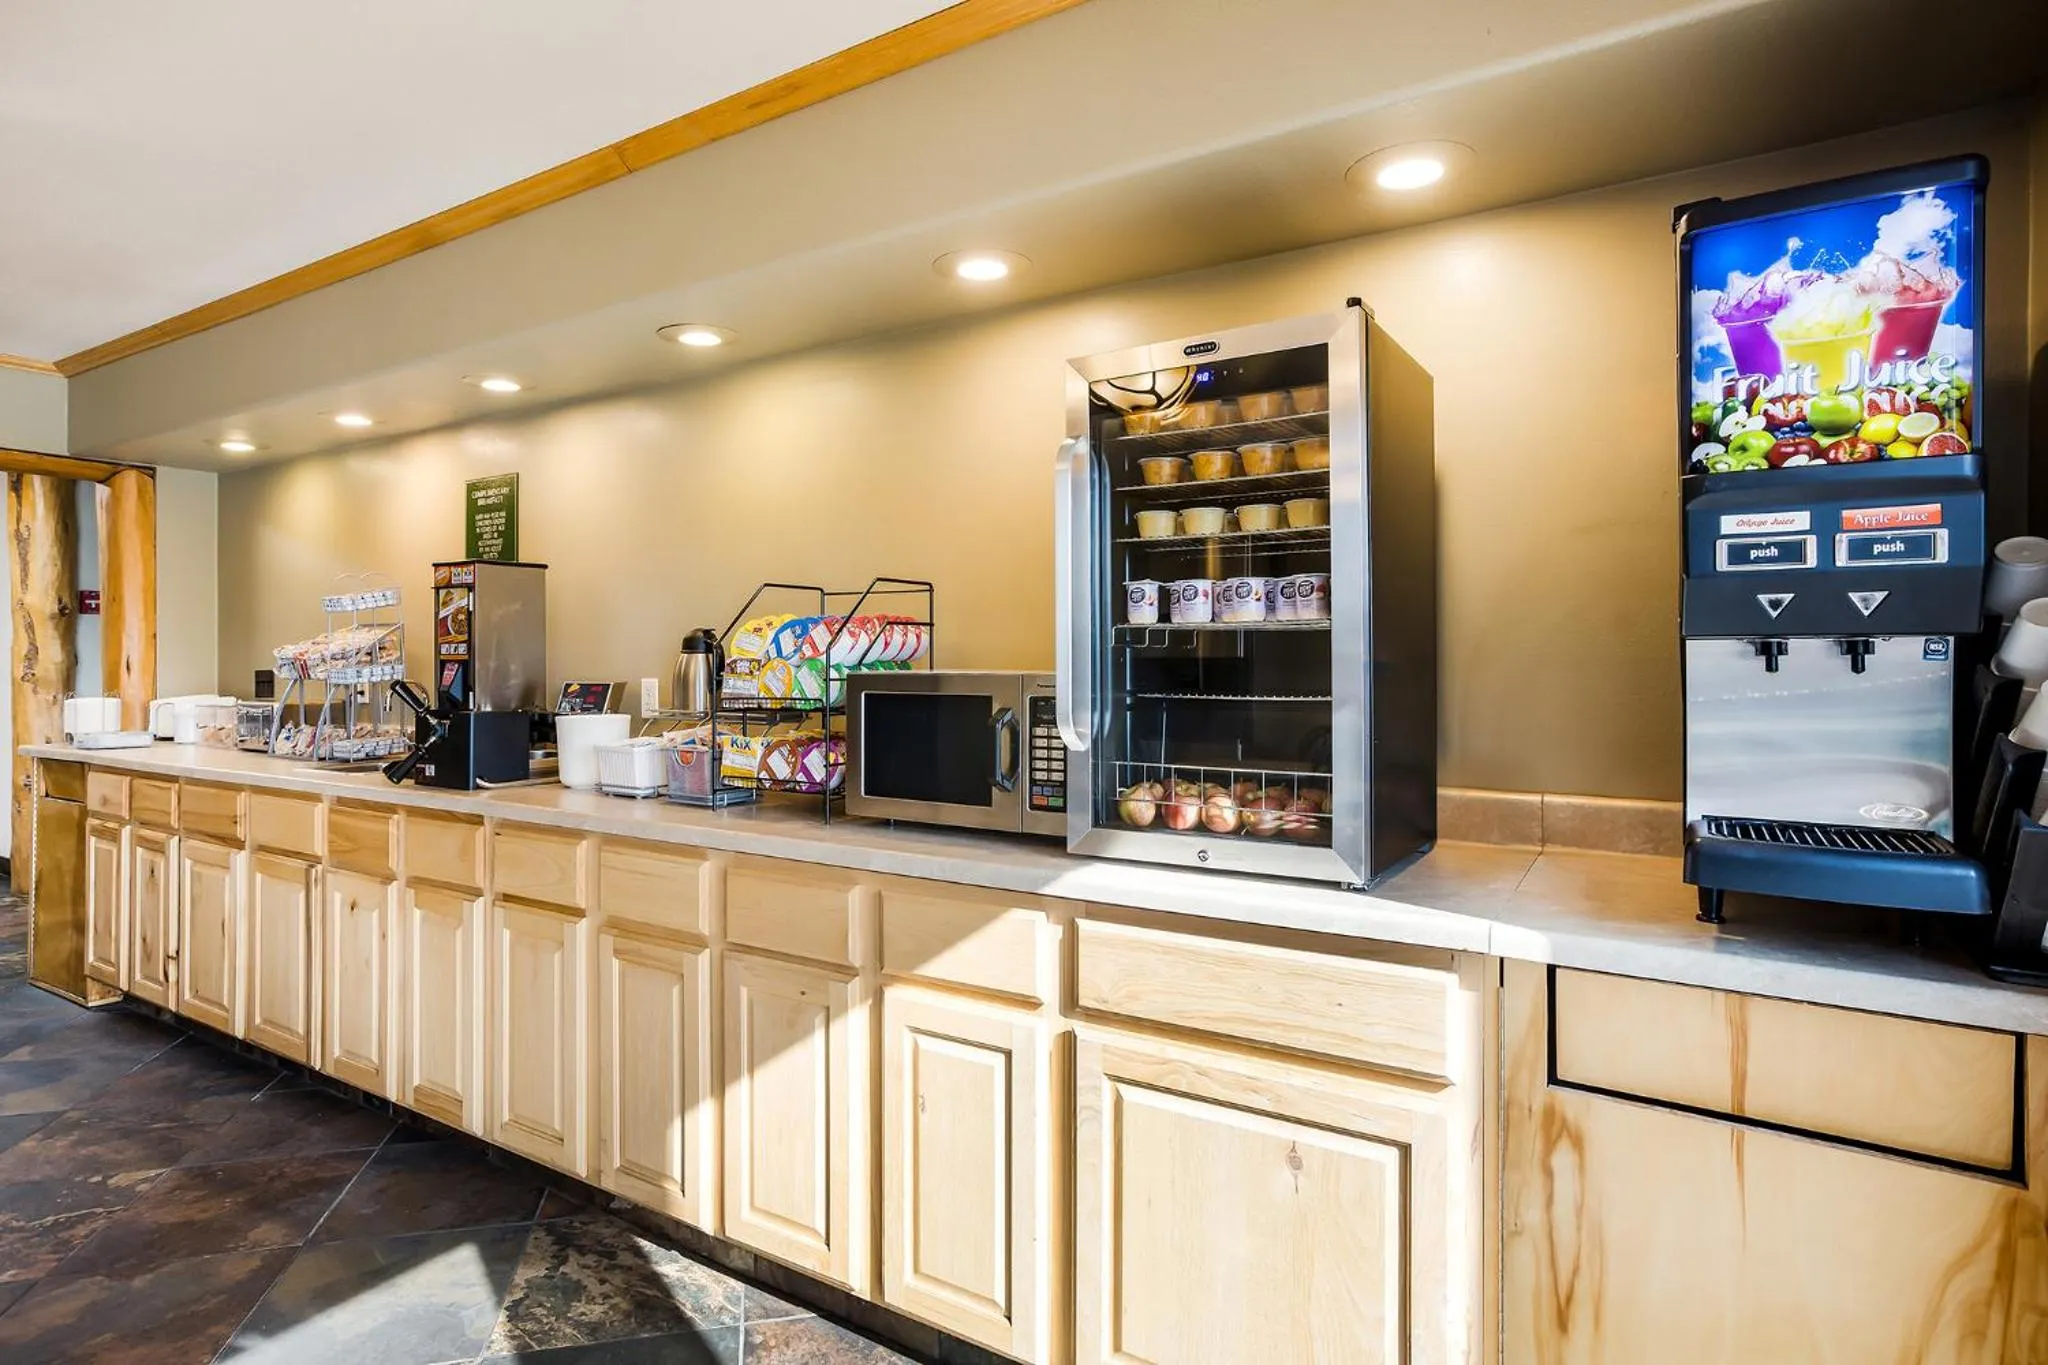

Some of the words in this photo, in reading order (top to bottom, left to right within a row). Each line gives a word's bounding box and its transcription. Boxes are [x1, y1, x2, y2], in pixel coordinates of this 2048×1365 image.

[1712, 362, 1819, 406] Fruit
[1837, 349, 1955, 393] Juice
[1770, 517, 1796, 525] Juice
[1854, 512, 1891, 526] Apple
[1896, 511, 1929, 522] Juice
[1750, 546, 1778, 560] push
[1873, 541, 1905, 555] push
